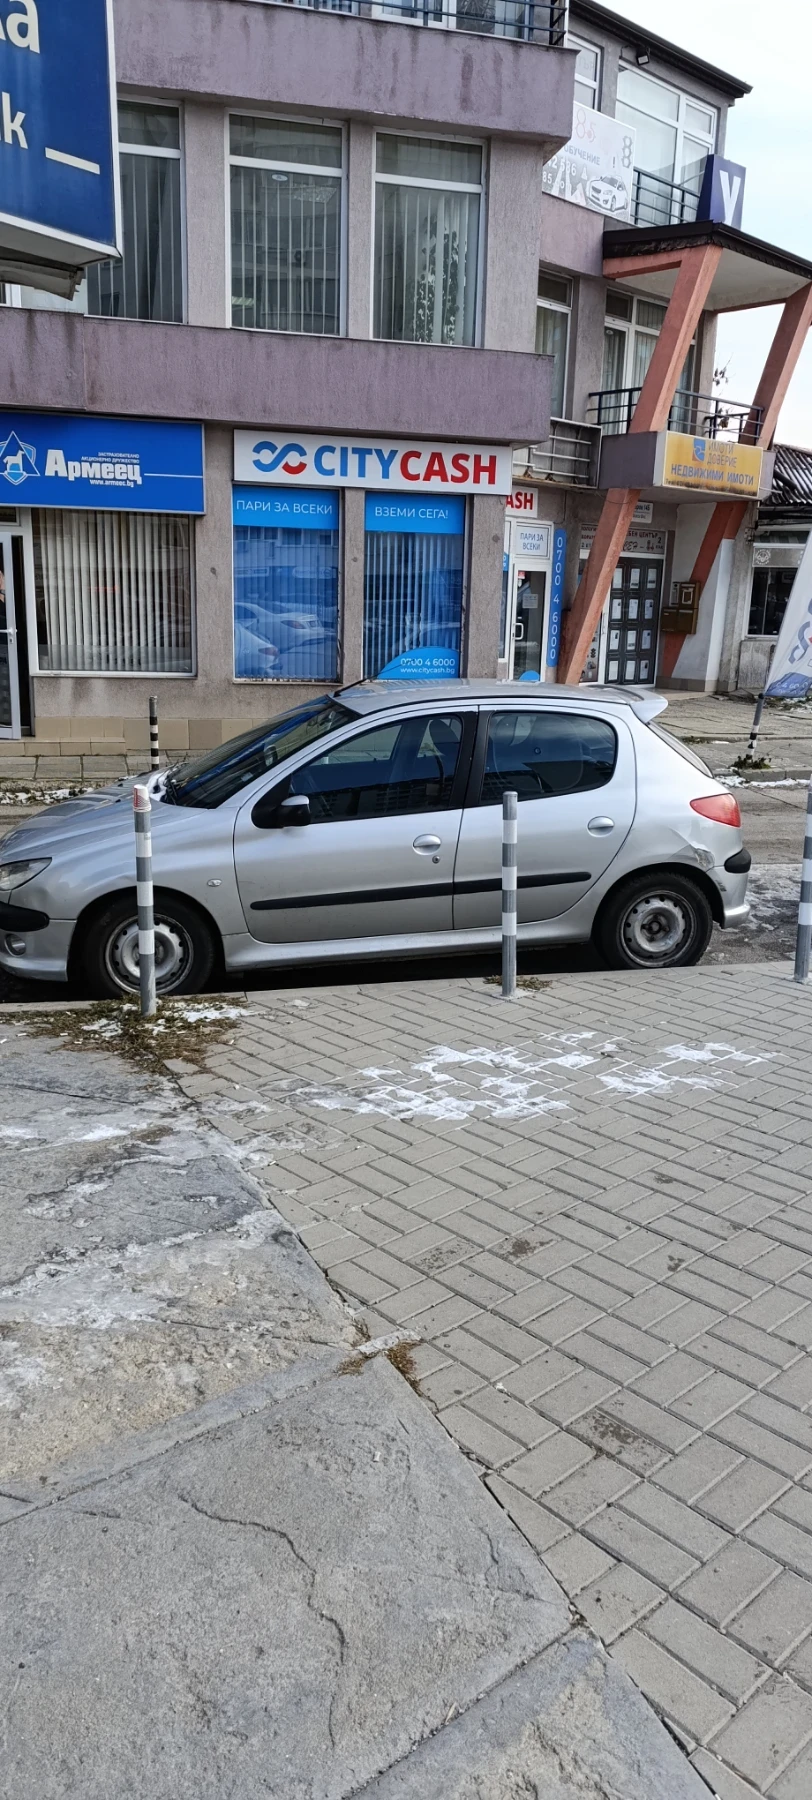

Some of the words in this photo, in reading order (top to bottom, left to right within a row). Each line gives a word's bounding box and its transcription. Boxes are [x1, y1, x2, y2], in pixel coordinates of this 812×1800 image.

[0, 0, 40, 53] а
[0, 92, 28, 149] k
[564, 145, 601, 166] ОБУЧЕНИЕ
[708, 442, 734, 454] ИМОТИ
[45, 449, 143, 485] Армеец
[707, 454, 737, 468] ДОВЕРИЕ
[671, 464, 724, 481] НЕДВИЖИМИ
[727, 472, 754, 485] ИМОТИ
[236, 500, 271, 512] ПАРИ
[274, 502, 290, 513] ЗА
[293, 503, 333, 515] ВСЕКИ
[375, 506, 415, 518] ВЗЕМИ
[418, 508, 448, 519] СЕГА!
[520, 533, 536, 542] ПАРИ
[537, 534, 544, 542] ЗА
[522, 542, 540, 551] ВСЕКИ
[554, 537, 563, 586] 0700
[553, 594, 560, 604] 4
[551, 612, 559, 659] 6000
[401, 658, 422, 666] 0700
[425, 658, 431, 666] 4
[433, 658, 455, 666] 6000
